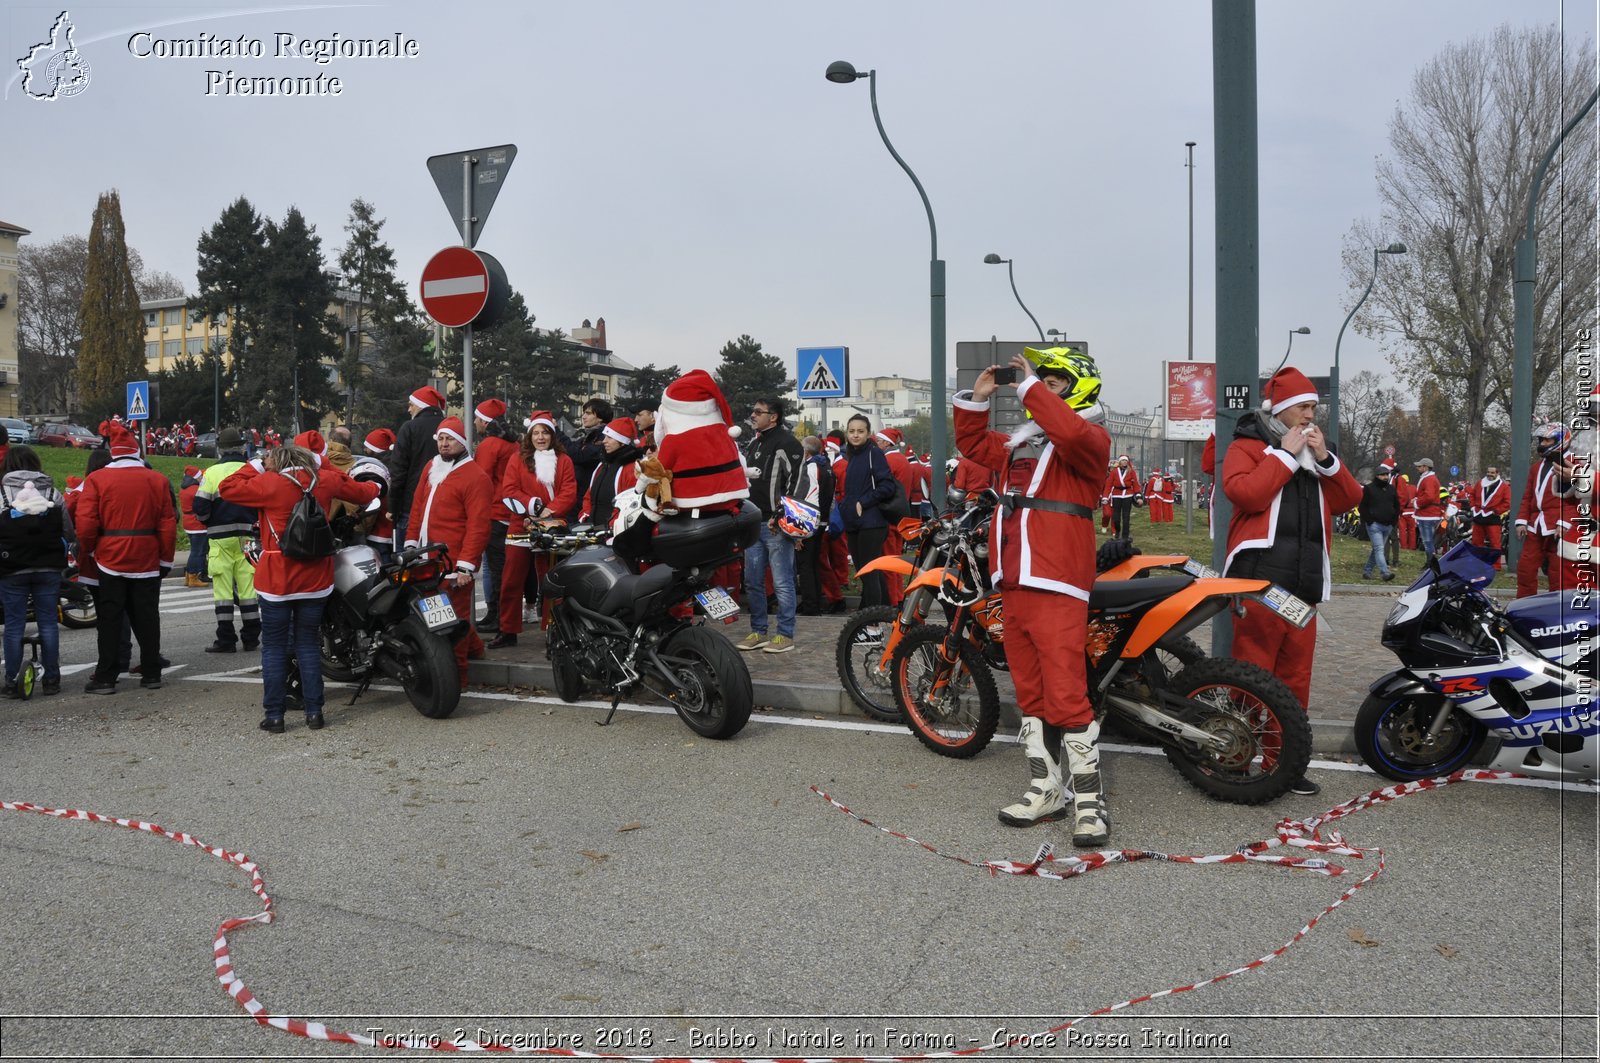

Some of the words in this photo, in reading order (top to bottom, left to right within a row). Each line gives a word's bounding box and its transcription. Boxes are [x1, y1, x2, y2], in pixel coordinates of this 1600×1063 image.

[425, 597, 439, 609] BX
[703, 590, 718, 602] EC
[708, 598, 736, 615] 36613
[428, 607, 455, 624] 42718
[1158, 720, 1183, 735] KTM
